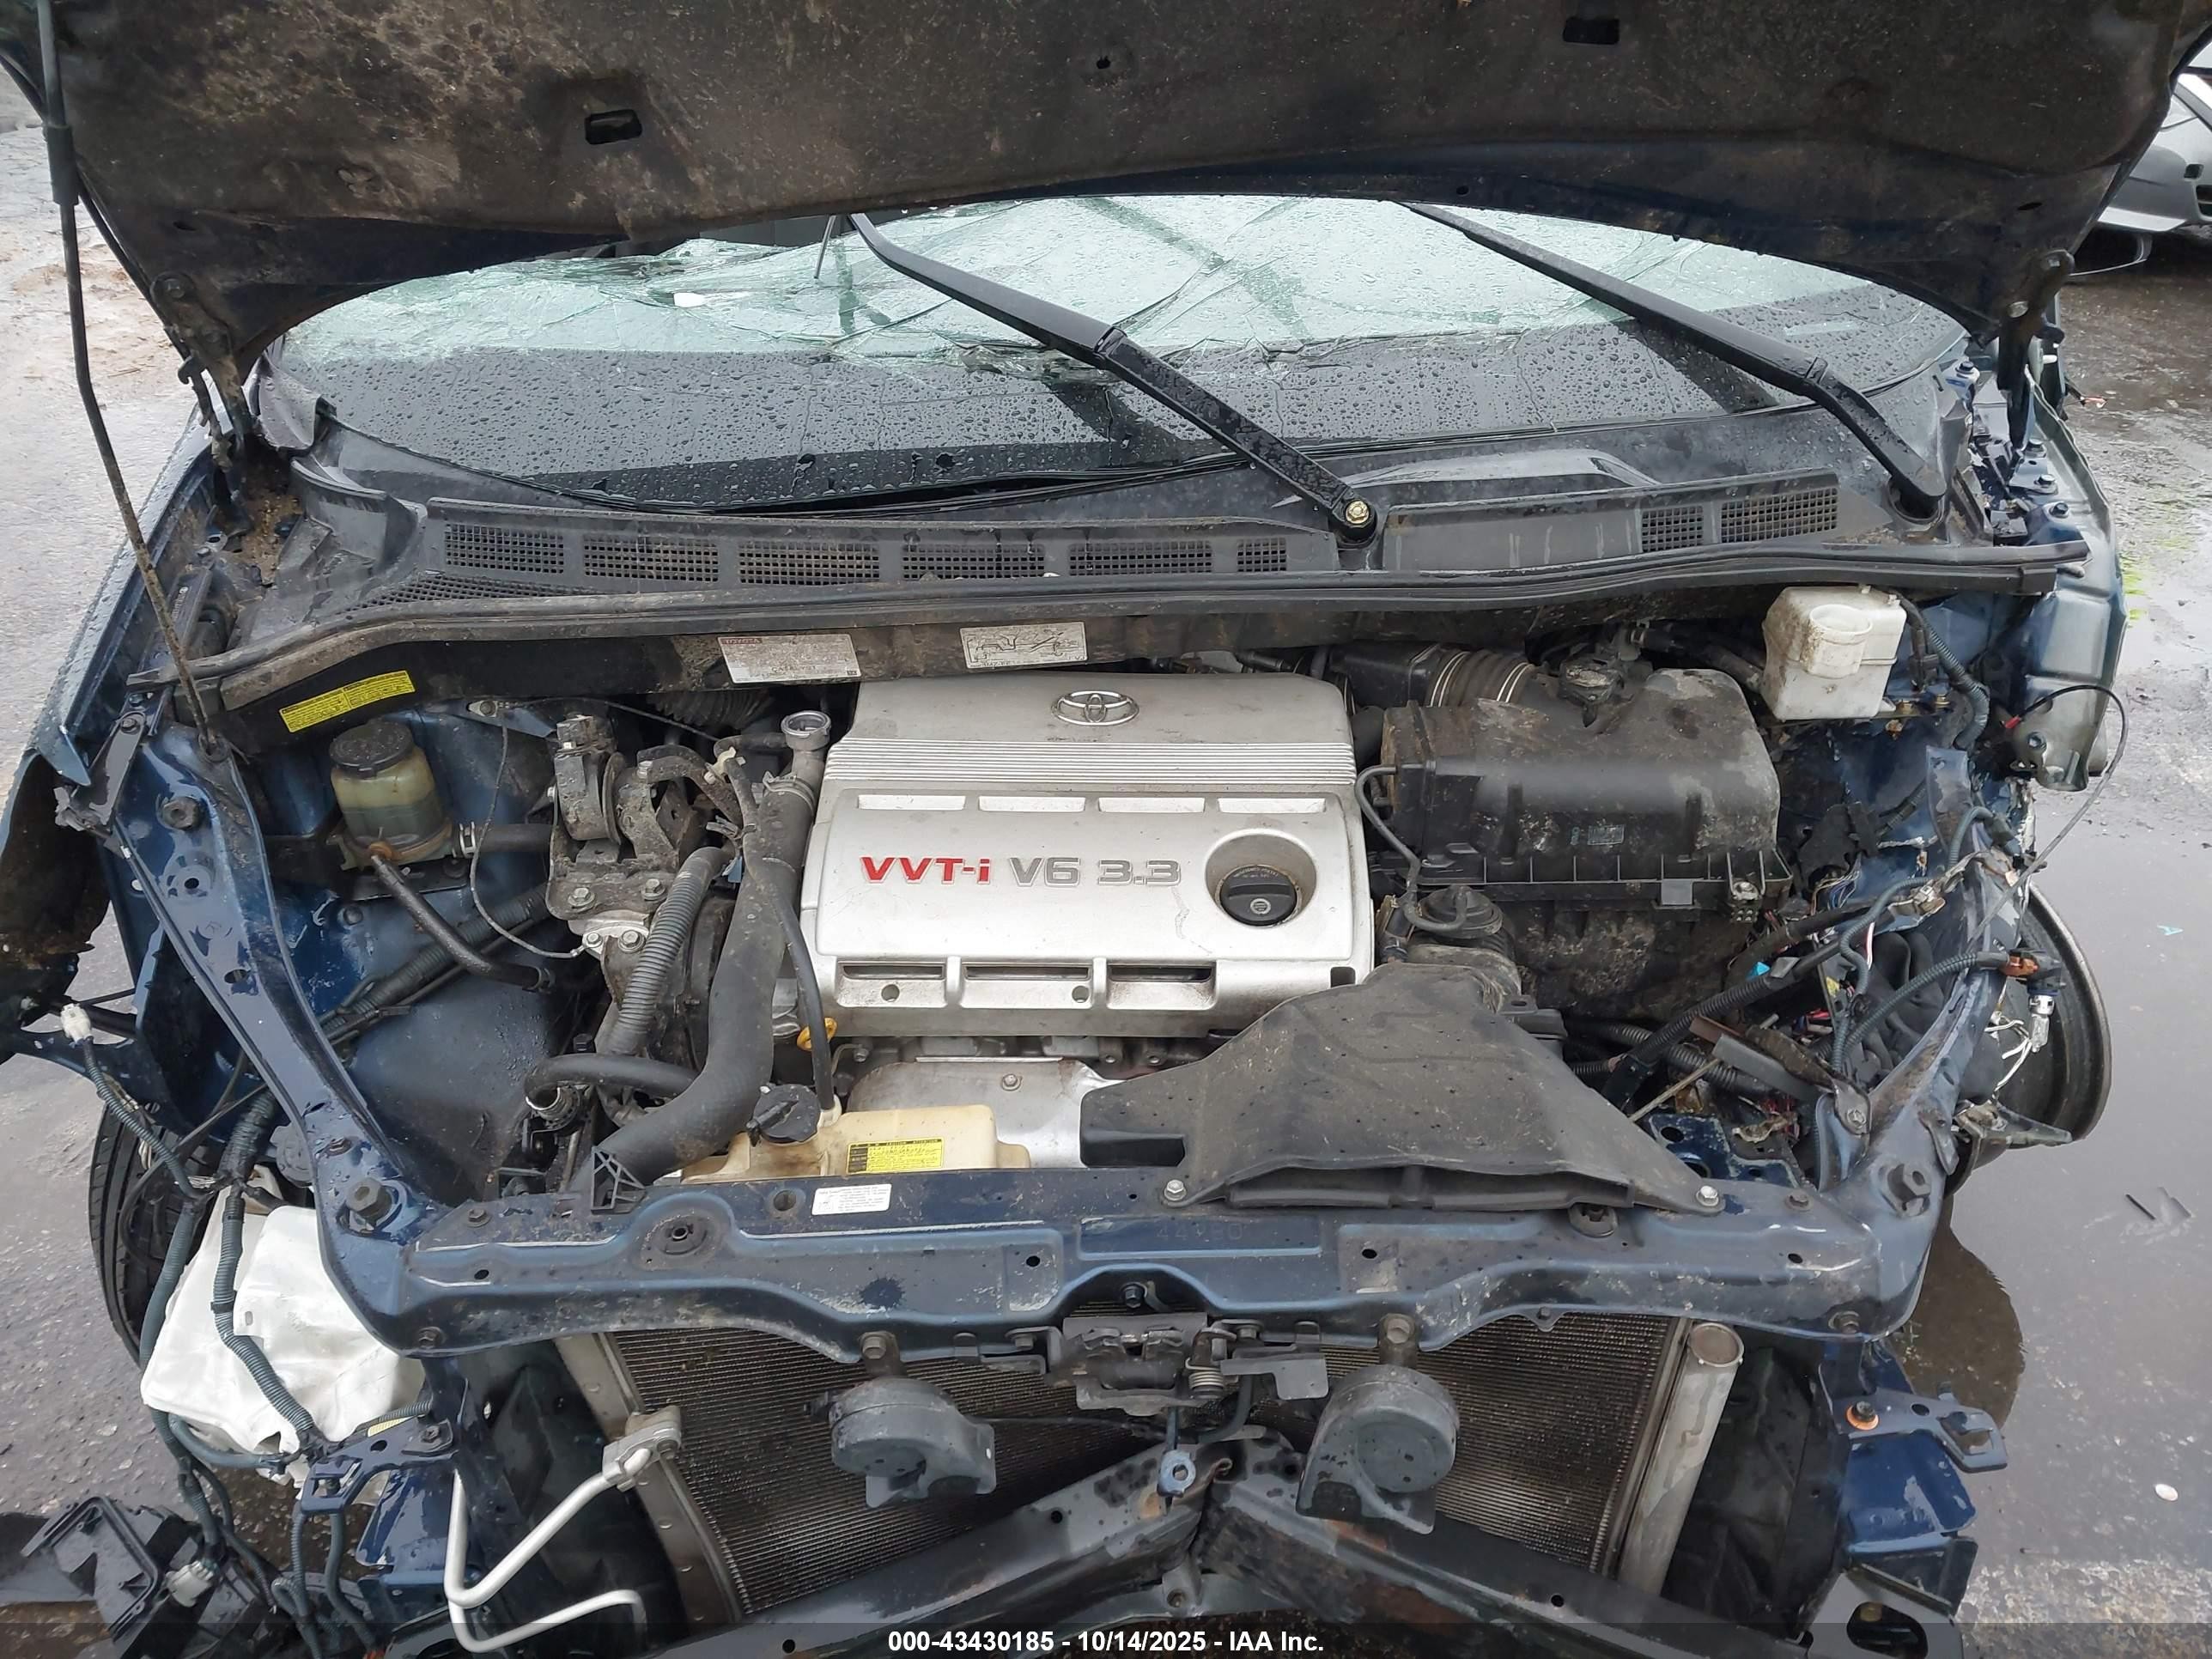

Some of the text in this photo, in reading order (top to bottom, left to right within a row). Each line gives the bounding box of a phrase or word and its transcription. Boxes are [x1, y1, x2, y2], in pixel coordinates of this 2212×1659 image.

[860, 857, 1182, 887] VVT-i V6 3.3
